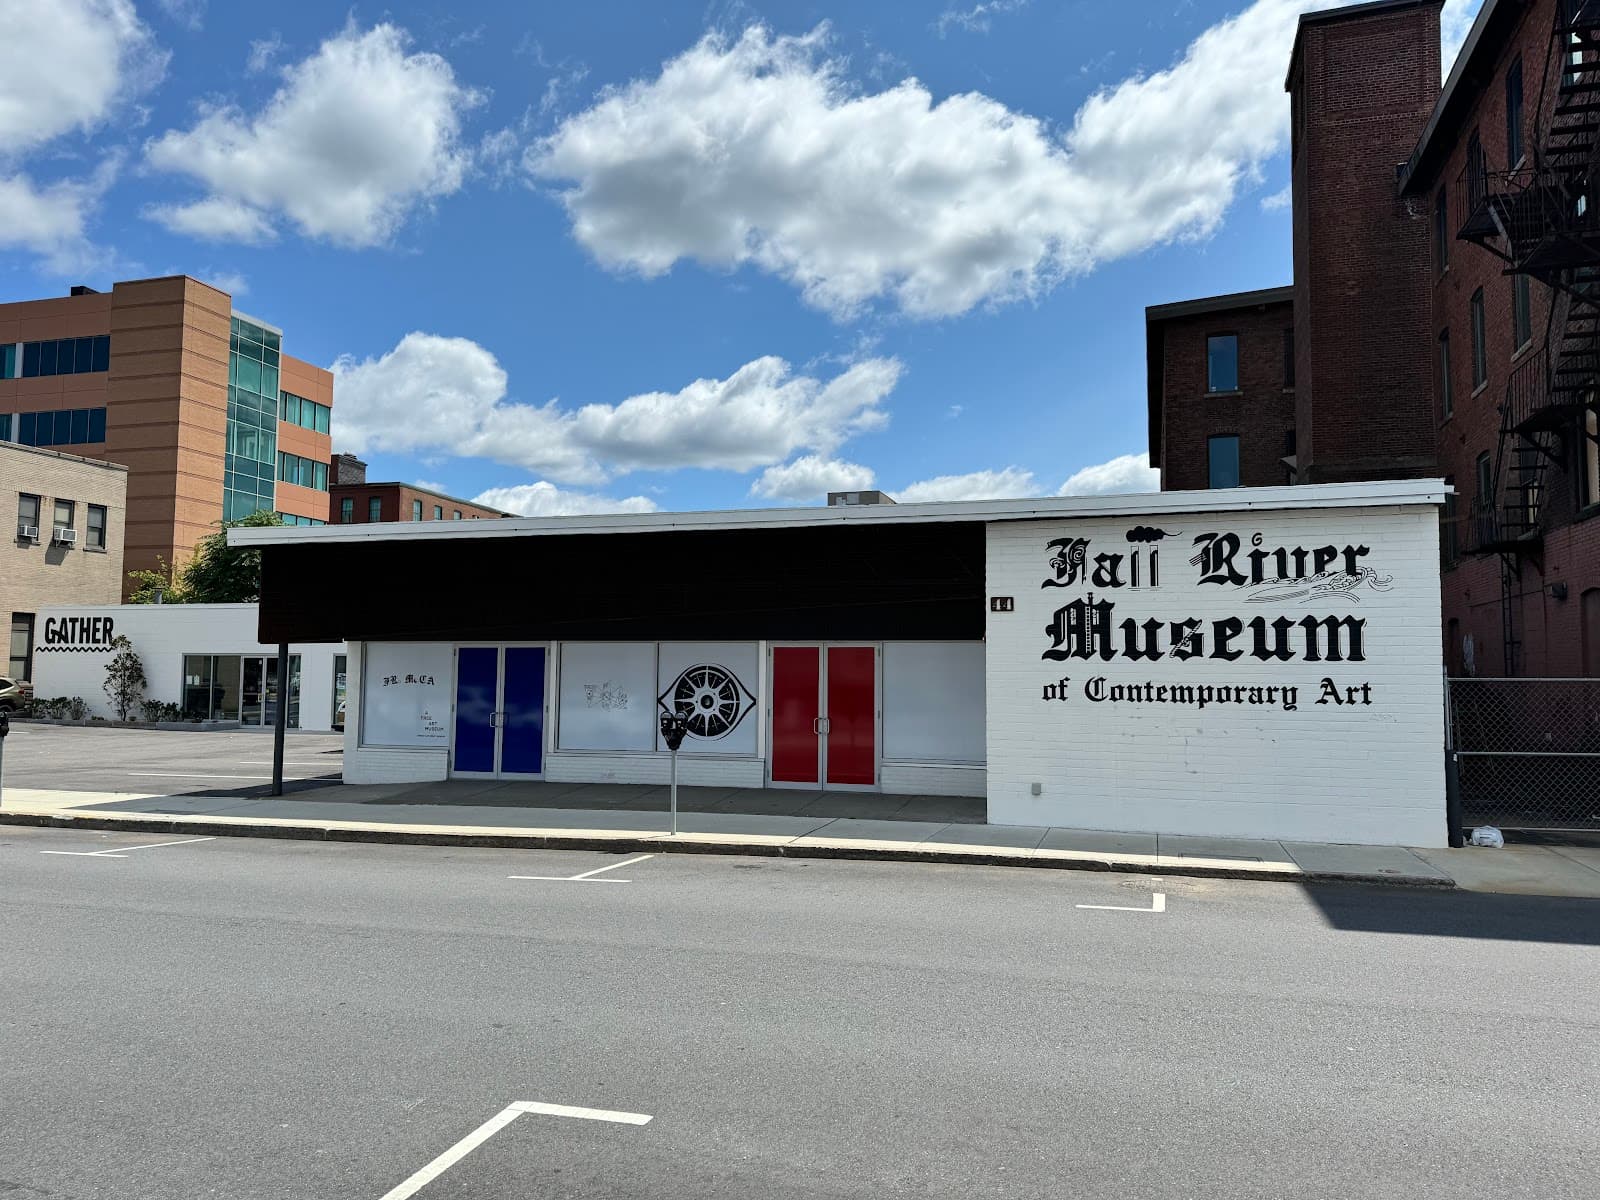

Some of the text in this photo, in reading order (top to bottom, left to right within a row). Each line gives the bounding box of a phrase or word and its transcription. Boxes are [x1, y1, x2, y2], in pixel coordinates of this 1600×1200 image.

[1041, 532, 1371, 592] Fall River
[45, 617, 114, 644] GATHER
[1041, 594, 1369, 662] Museum
[1042, 677, 1373, 711] of Contemporary Art
